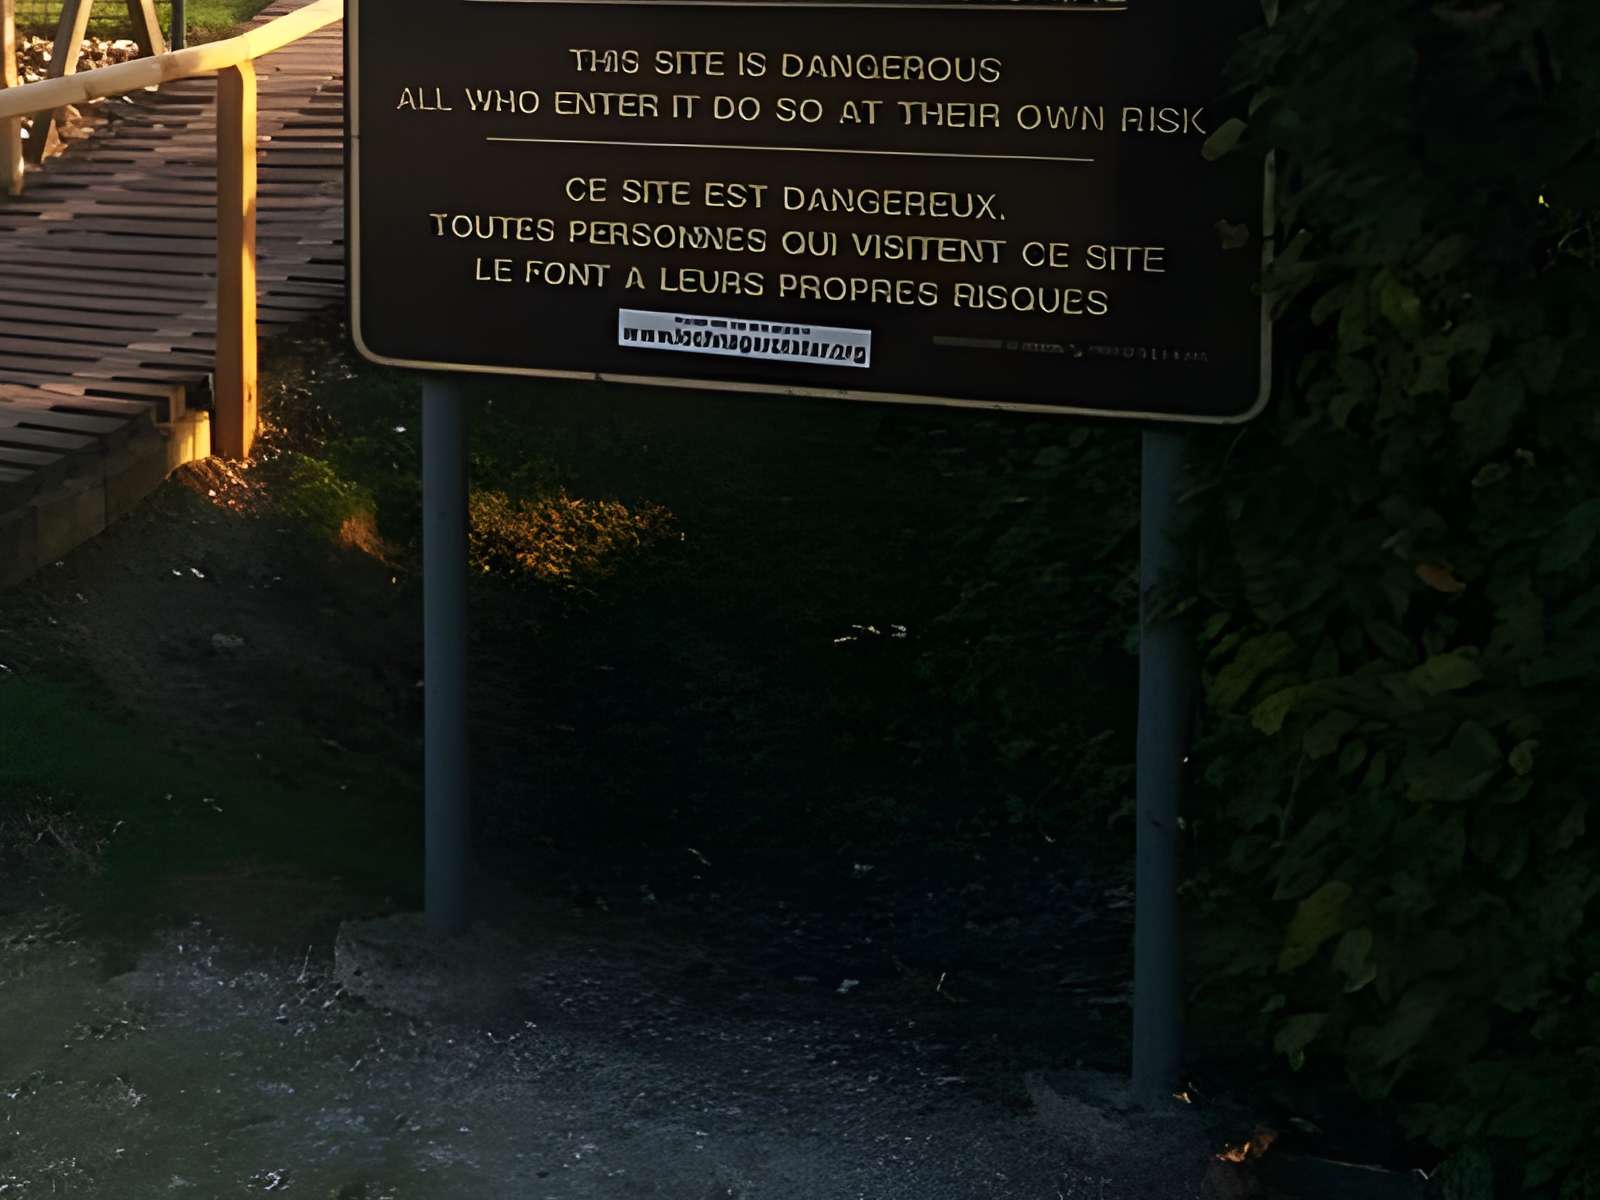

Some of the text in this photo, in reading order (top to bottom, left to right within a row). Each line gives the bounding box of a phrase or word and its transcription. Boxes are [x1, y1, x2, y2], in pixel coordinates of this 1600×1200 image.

[569, 48, 639, 74] THIS
[654, 50, 725, 76] SITE
[738, 51, 767, 77] IS
[396, 87, 1206, 134] ALL WHO ENTER IT DO SO AT THEIR OWN RISK
[565, 176, 607, 202] CE
[622, 179, 691, 206] SITE
[704, 182, 768, 209] EST
[429, 213, 555, 242] TOUTES
[569, 220, 767, 253] PERSONNES
[851, 232, 1007, 264] VISITENT
[1086, 244, 1165, 273] SITE
[475, 257, 513, 283] LE
[525, 260, 611, 288] FONT
[660, 267, 764, 296] LEURS
[779, 273, 938, 307] PROPRES
[953, 282, 1108, 316] RISQUES
